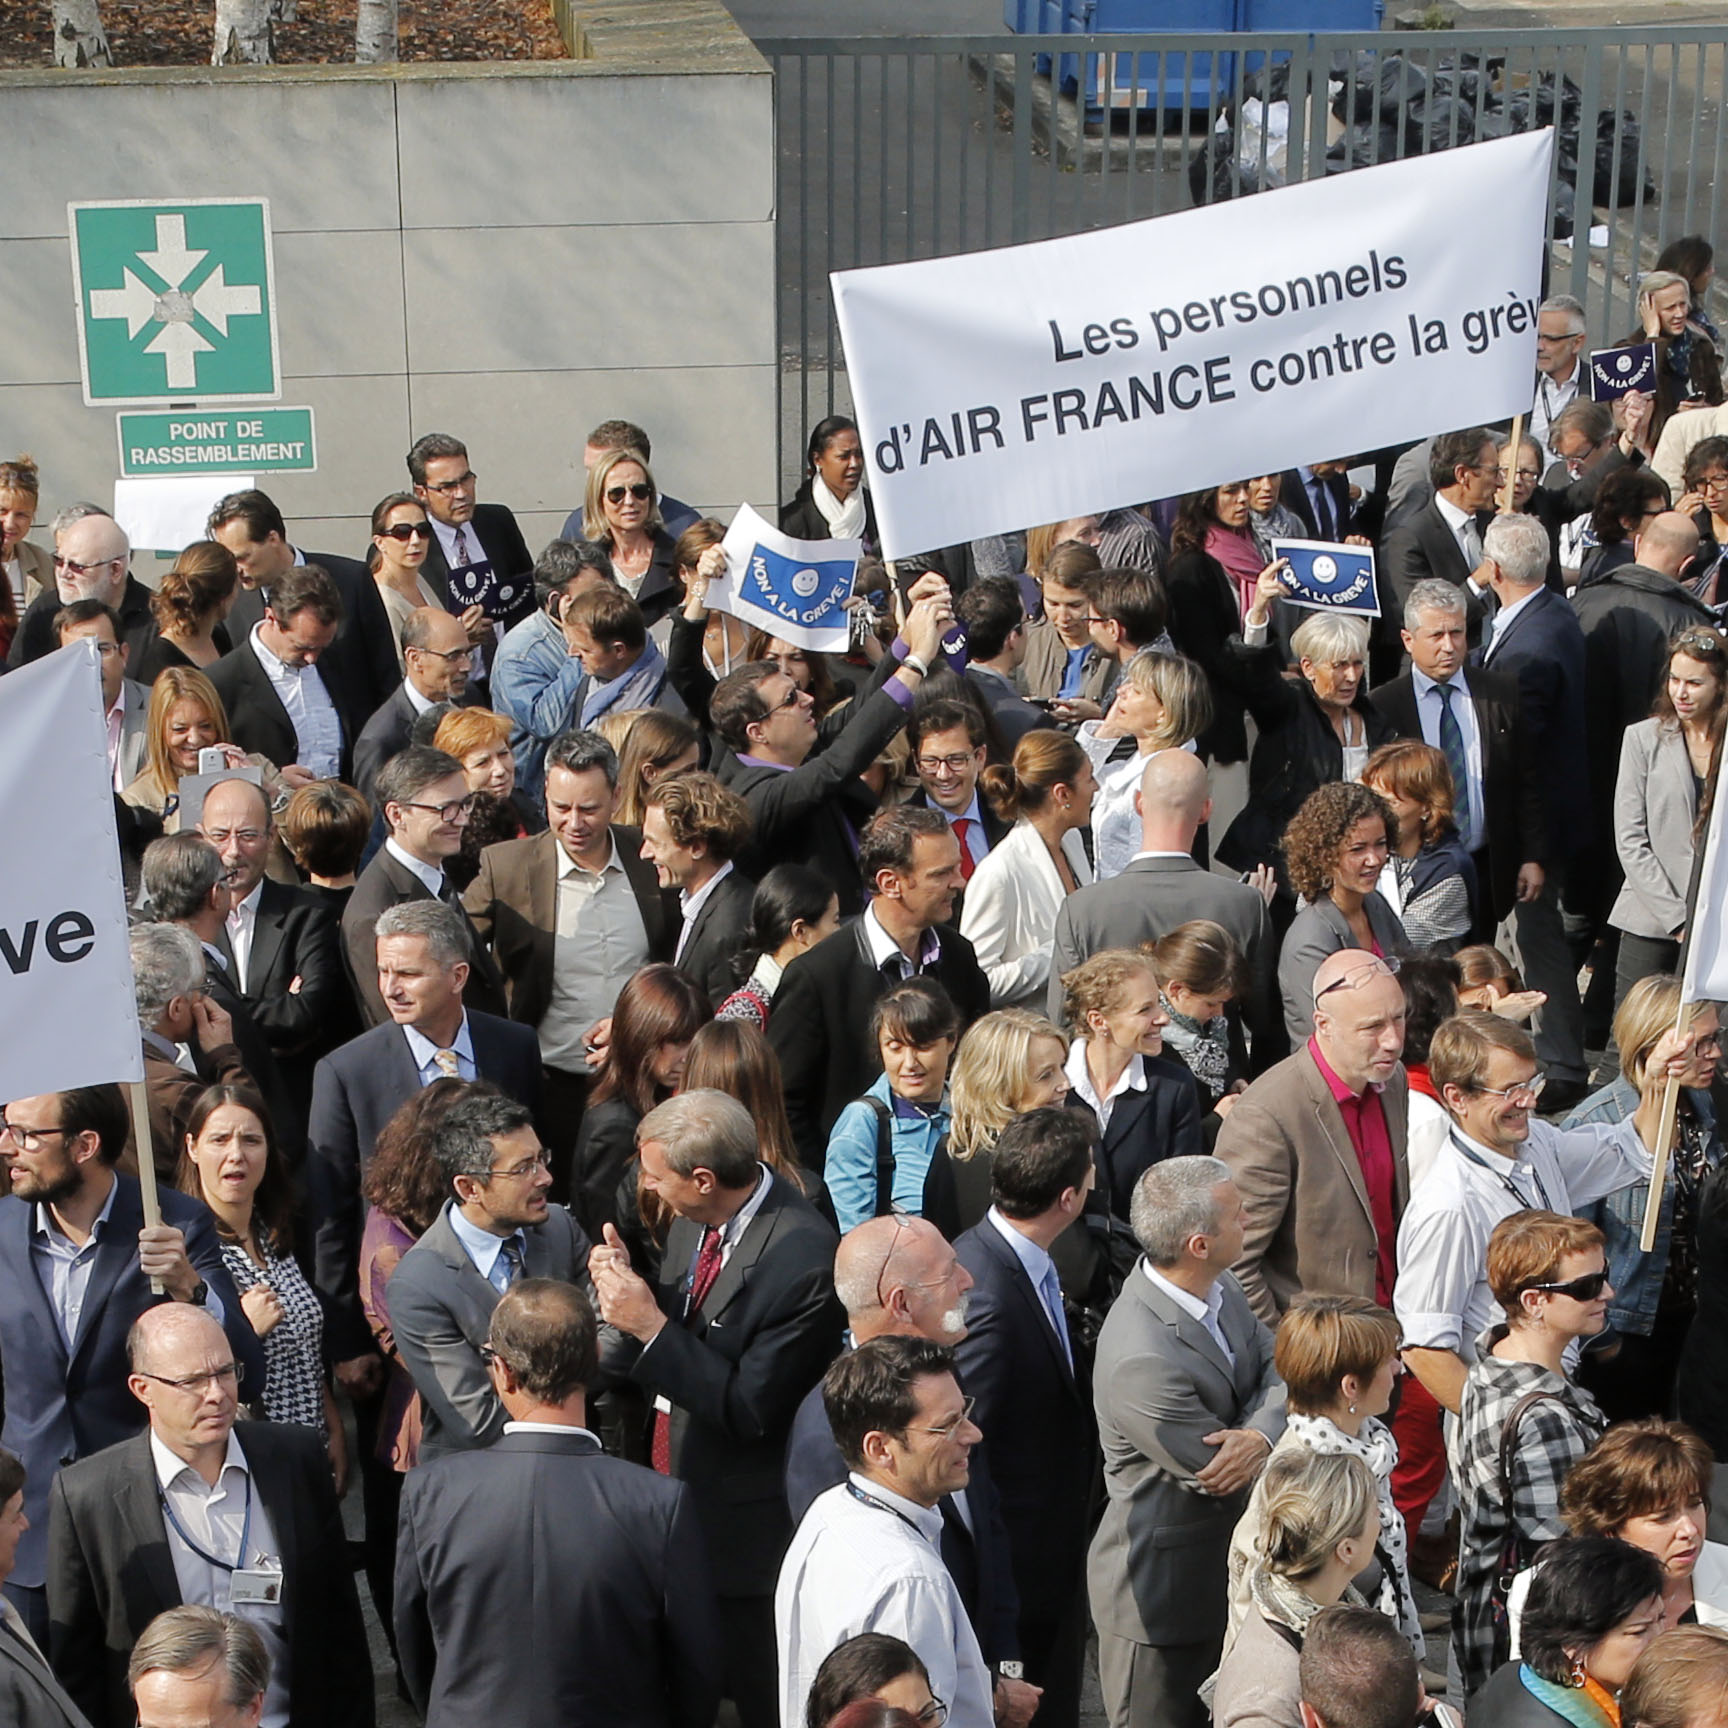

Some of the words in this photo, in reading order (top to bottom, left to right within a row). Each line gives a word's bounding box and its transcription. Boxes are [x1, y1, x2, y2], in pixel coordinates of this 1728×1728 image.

[1049, 315, 1138, 362] Les
[1150, 250, 1408, 350] personnels
[875, 406, 1004, 475] d'AIR
[1020, 357, 1235, 442] FRANCE
[1250, 331, 1395, 391] contre
[1409, 315, 1448, 356] la
[1463, 289, 1540, 353] grèv
[1616, 380, 1628, 388] LA
[169, 422, 228, 440] POINT
[237, 420, 264, 438] DE
[131, 442, 304, 465] RASSEMBLEMENT
[752, 556, 772, 592] NON
[765, 594, 779, 606] A
[777, 601, 799, 621] LA
[801, 584, 845, 623] GREVE
[1282, 564, 1301, 589] ON
[1300, 587, 1310, 597] A
[1313, 591, 1331, 604] LA
[1332, 575, 1368, 604] GREVE
